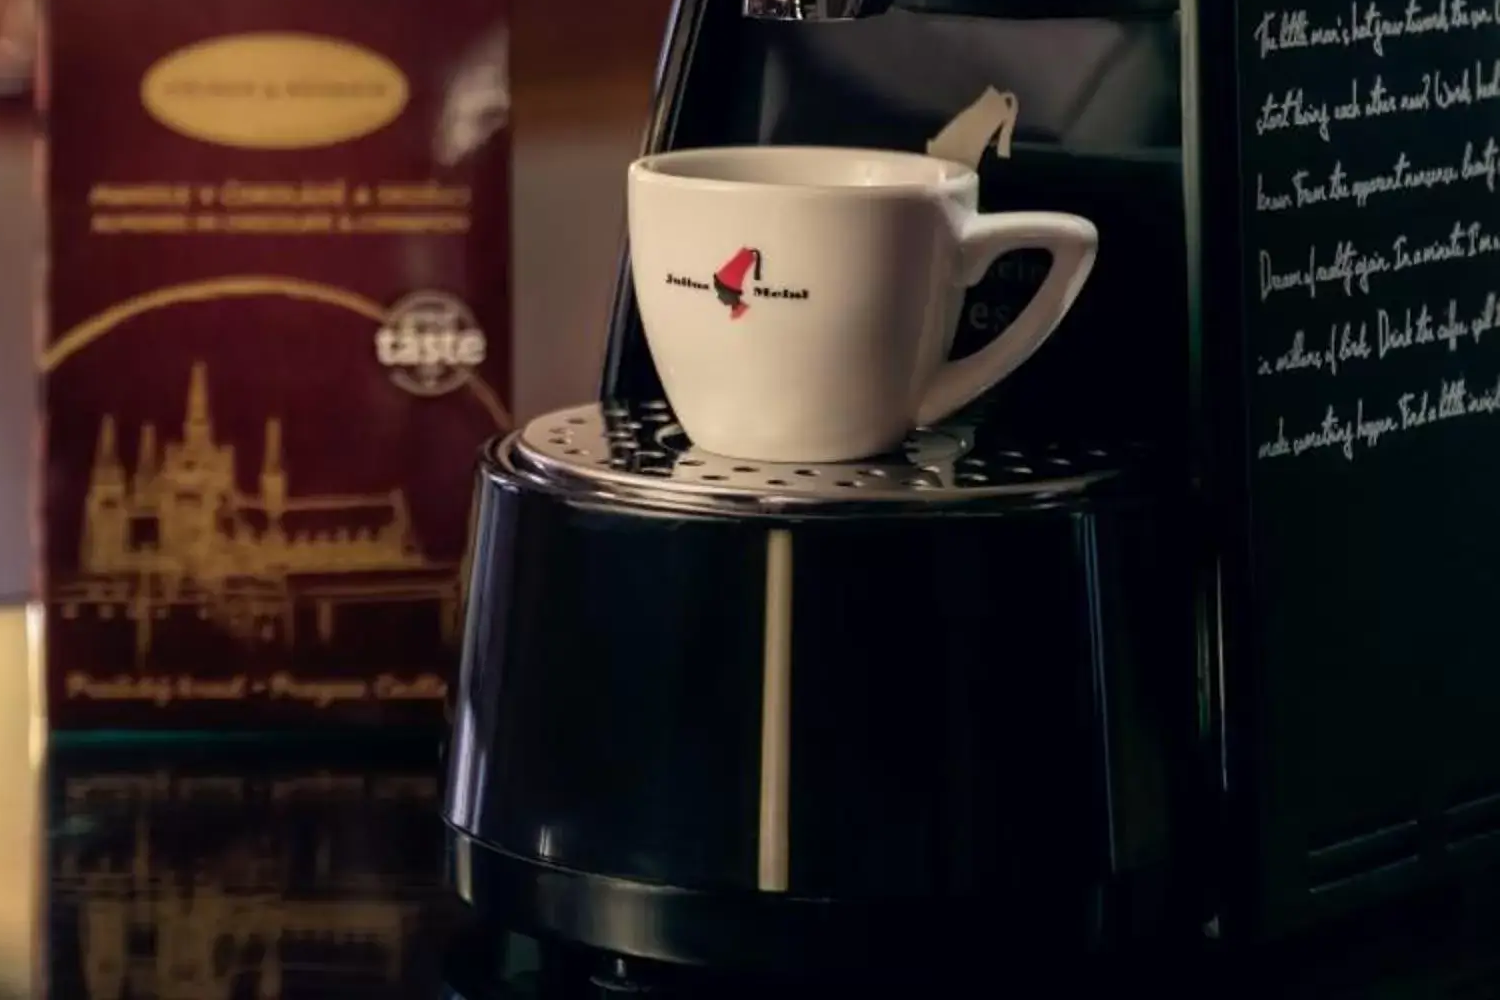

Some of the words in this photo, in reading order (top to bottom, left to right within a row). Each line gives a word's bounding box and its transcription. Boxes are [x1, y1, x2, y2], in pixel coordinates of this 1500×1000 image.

[1254, 10, 1278, 59] The
[1279, 9, 1309, 48] little
[1329, 160, 1351, 201] the
[665, 273, 710, 291] Julius
[753, 286, 810, 301] Meinl
[1414, 304, 1435, 344] the
[375, 327, 486, 366] taste
